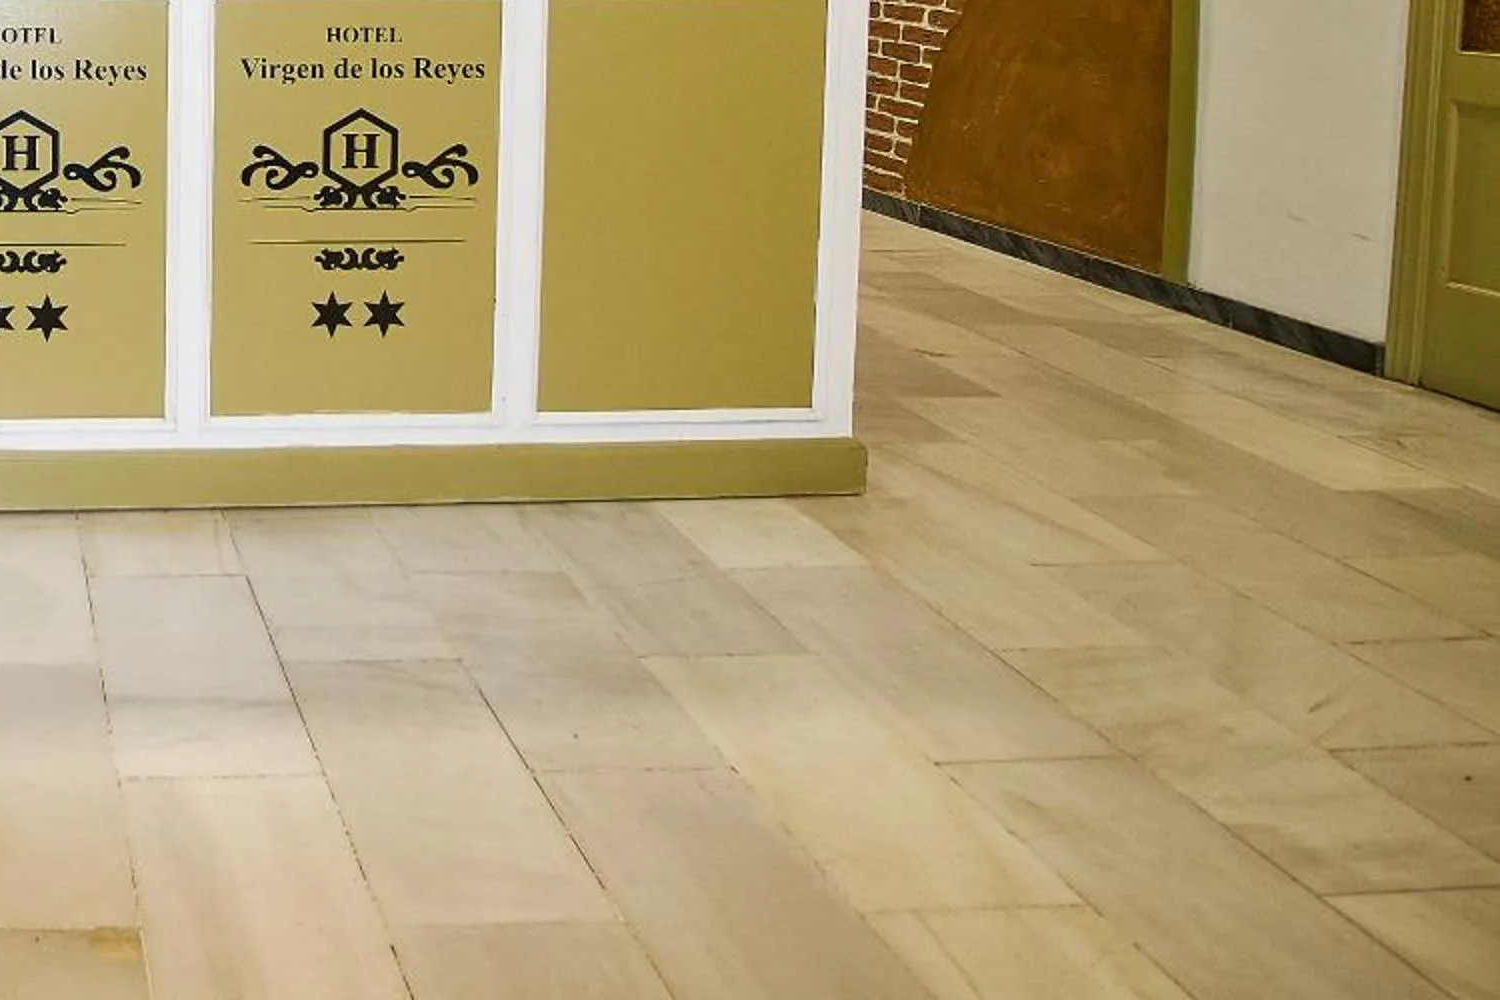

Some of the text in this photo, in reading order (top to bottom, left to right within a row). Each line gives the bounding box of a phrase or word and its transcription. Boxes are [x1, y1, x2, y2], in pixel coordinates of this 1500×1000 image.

[326, 27, 403, 43] HOTEL
[31, 59, 65, 80] los
[75, 59, 147, 87] Reyes
[241, 58, 485, 85] Virgen de los Reyes
